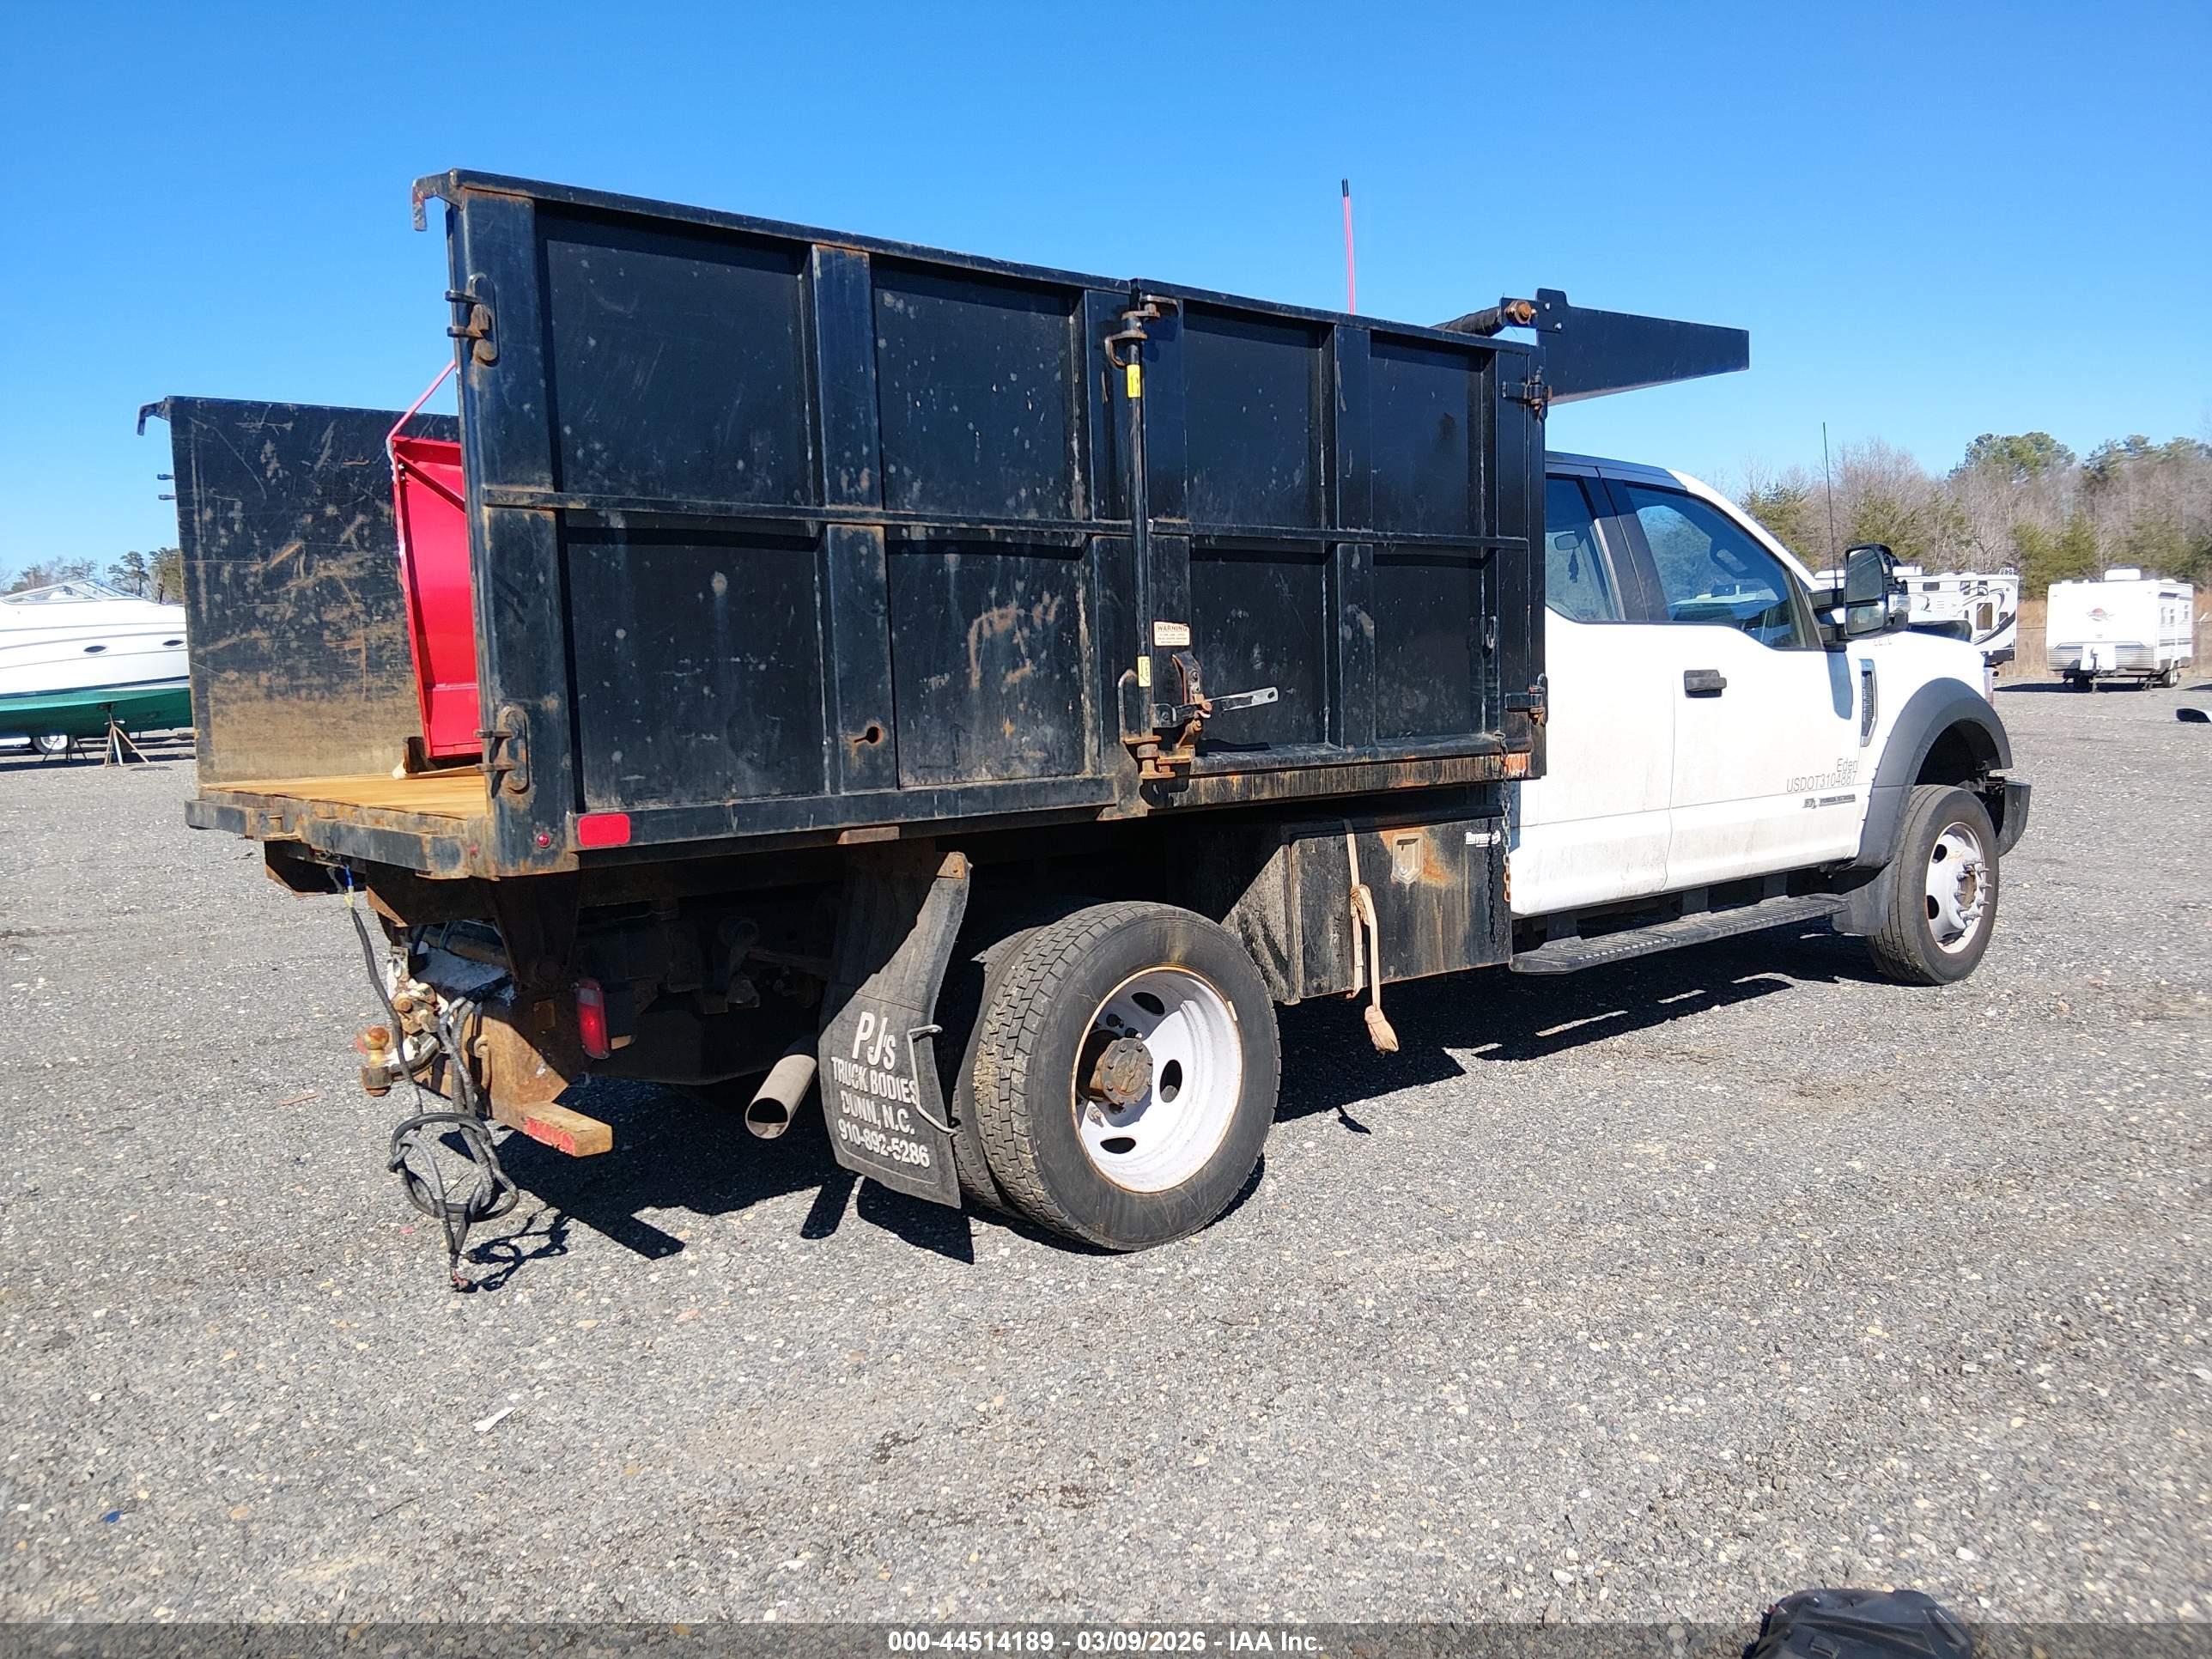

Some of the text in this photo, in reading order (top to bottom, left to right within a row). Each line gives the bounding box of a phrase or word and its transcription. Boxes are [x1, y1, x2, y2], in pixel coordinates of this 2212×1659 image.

[1786, 770, 1857, 792] USDOT3104887
[831, 1056, 918, 1105] TRUCK BODIES
[840, 1091, 915, 1135] DUNN, N.C.
[837, 1119, 930, 1168] 910-892-5286
